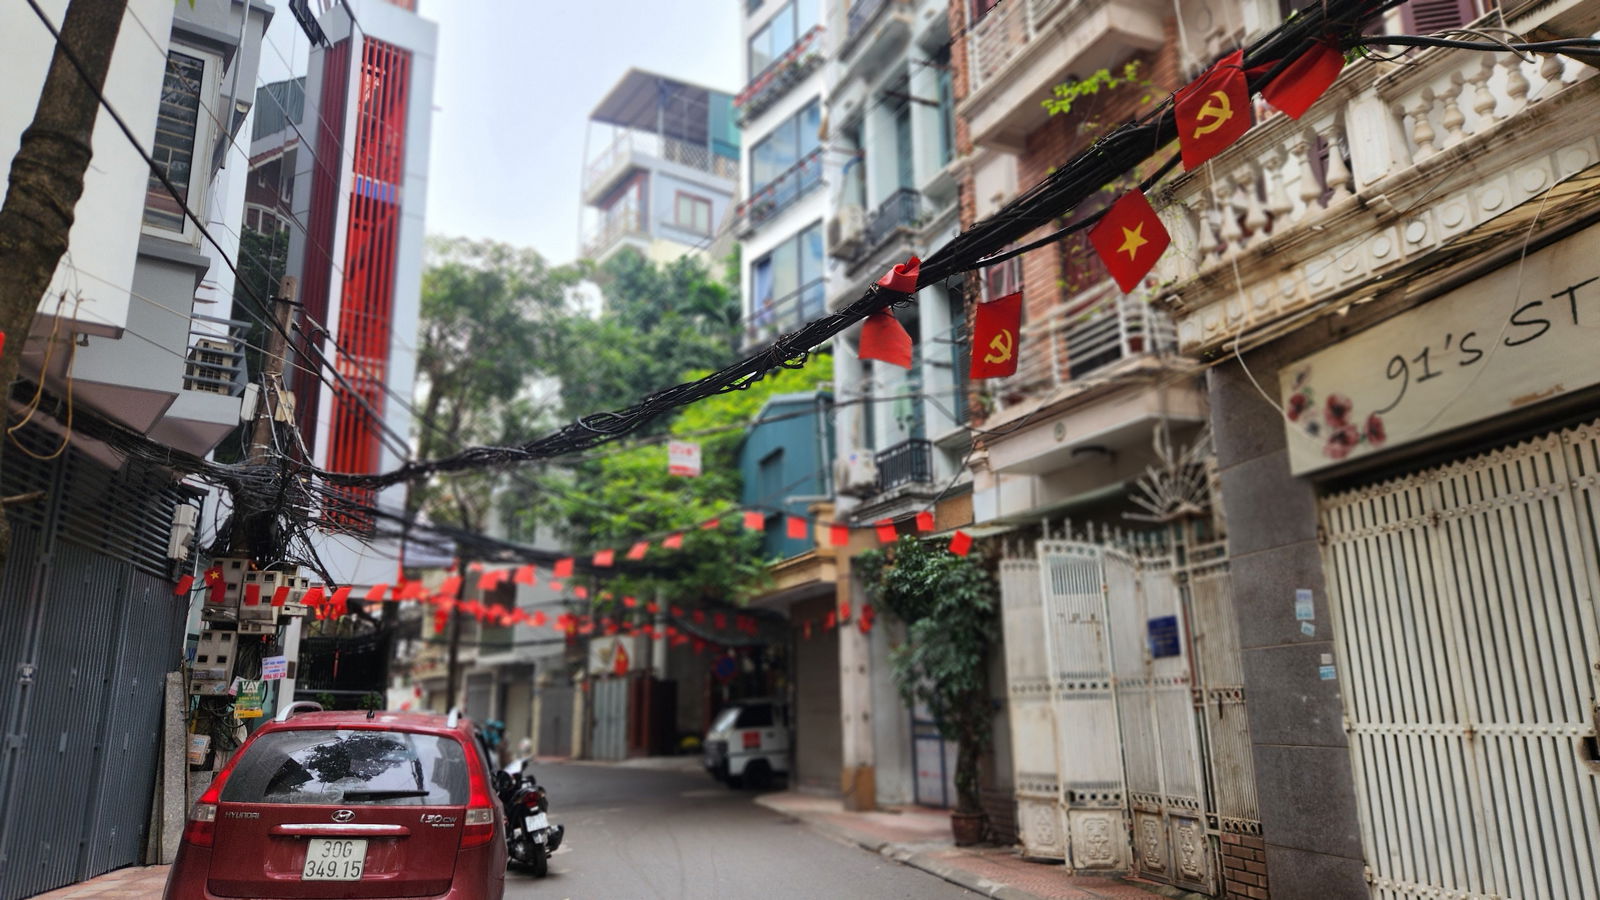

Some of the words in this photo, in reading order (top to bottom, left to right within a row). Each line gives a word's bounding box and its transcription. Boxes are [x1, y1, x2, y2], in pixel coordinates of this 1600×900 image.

[242, 681, 260, 691] VAY
[224, 811, 260, 819] HYUNDAI
[321, 840, 353, 858] 30G
[305, 860, 362, 878] 349.15
